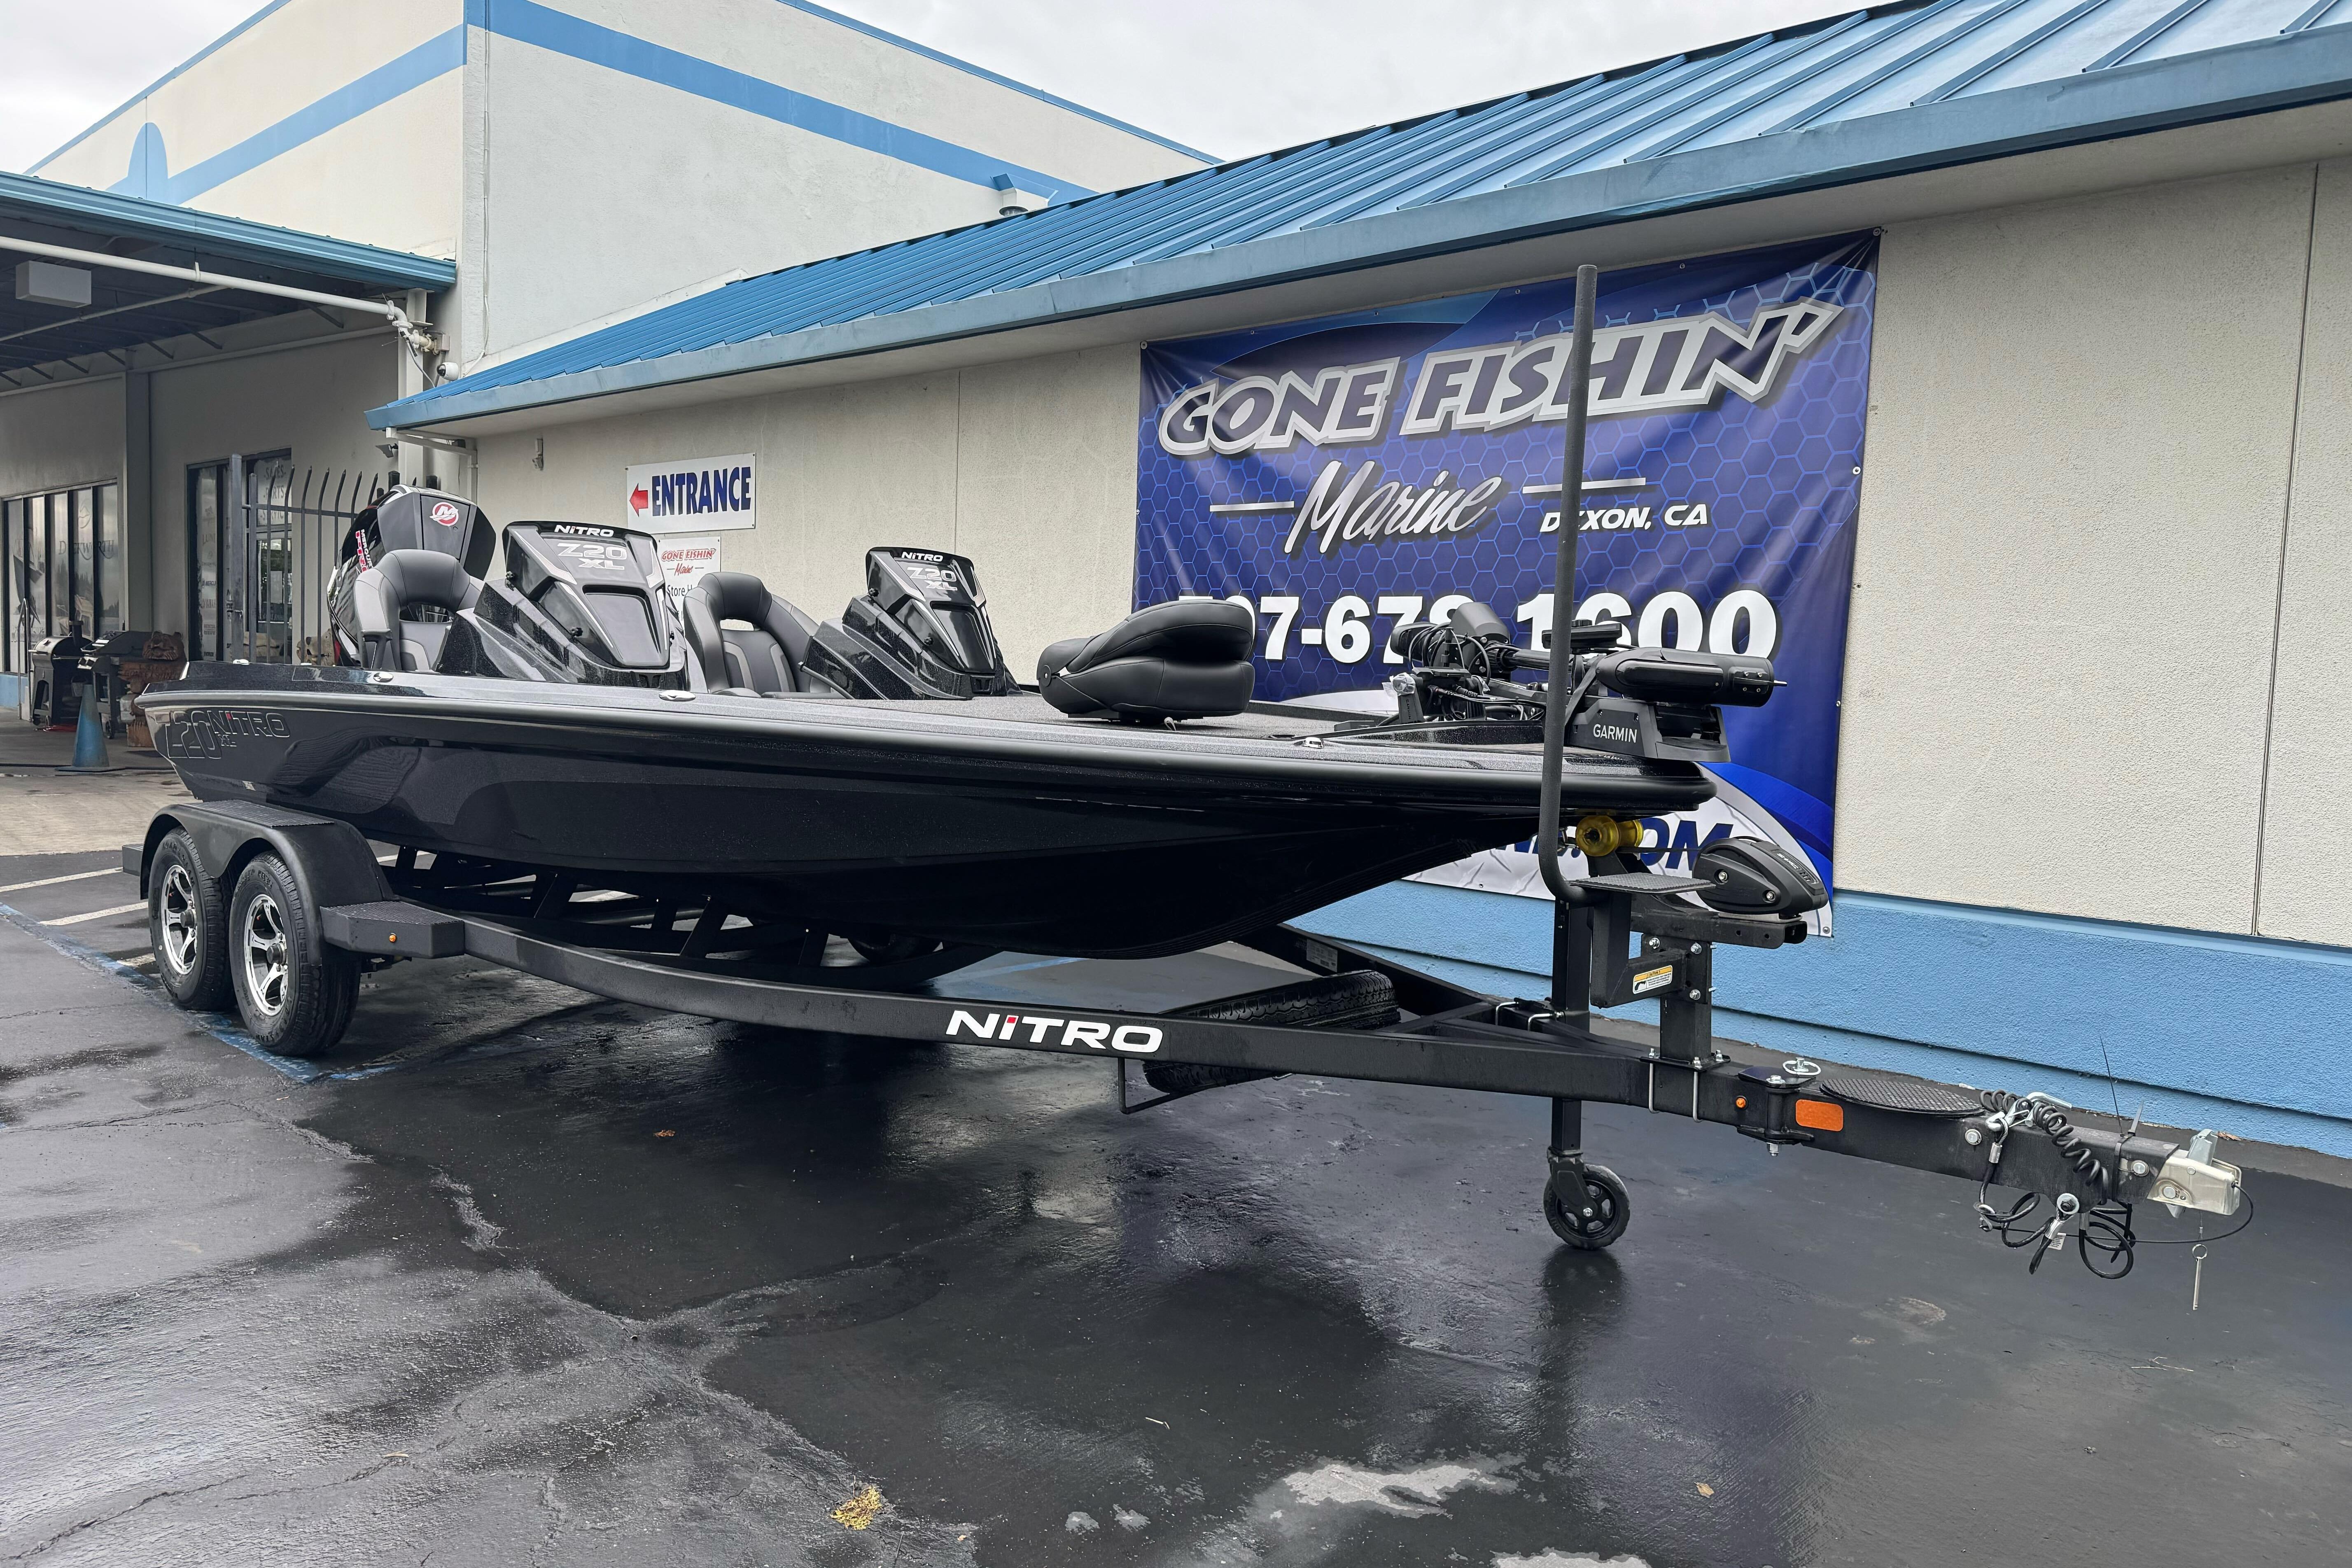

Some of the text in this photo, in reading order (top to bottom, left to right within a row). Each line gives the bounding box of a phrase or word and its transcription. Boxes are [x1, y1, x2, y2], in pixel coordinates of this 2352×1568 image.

[1159, 357, 1401, 456] GONE
[652, 466, 751, 517] ENTRANCE
[1283, 460, 1502, 553] Marine
[1540, 504, 1707, 532] DXON, CA
[554, 525, 614, 537] NITRO
[558, 543, 627, 560] Z20
[661, 549, 684, 562] GONE
[901, 552, 943, 562] NITRO
[579, 558, 625, 570] XL
[907, 567, 957, 582] Z20
[667, 585, 685, 597] Store
[924, 580, 957, 590] XL
[207, 710, 290, 737] NITRO
[1593, 724, 1637, 743] GARMIN
[946, 1010, 1163, 1053] NITRO
